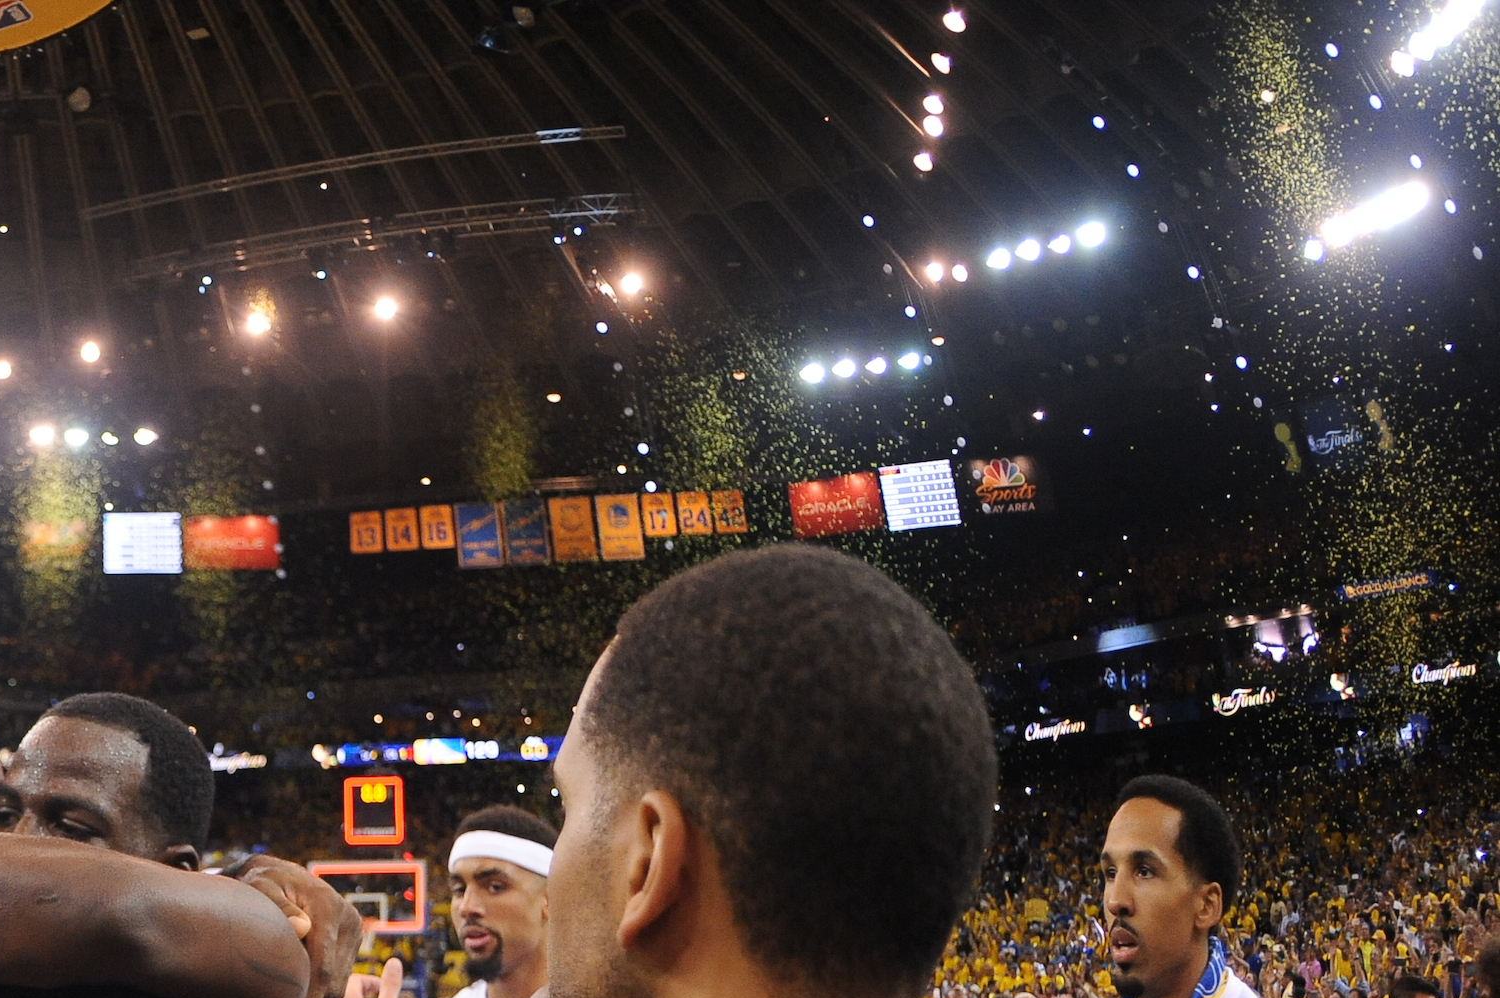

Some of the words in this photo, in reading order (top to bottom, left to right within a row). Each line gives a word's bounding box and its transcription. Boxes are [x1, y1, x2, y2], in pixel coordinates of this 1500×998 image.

[976, 483, 1036, 504] Sports
[801, 497, 868, 516] ORACLE
[1007, 502, 1036, 512] AREA
[680, 508, 708, 528] 24
[720, 507, 745, 527] 42
[357, 527, 376, 547] 13
[393, 525, 412, 544] 14
[428, 522, 447, 542] 16
[1355, 583, 1382, 595] GOLD
[1411, 660, 1477, 686] Champions
[1225, 686, 1271, 714] Finals
[1025, 719, 1086, 742] Champions
